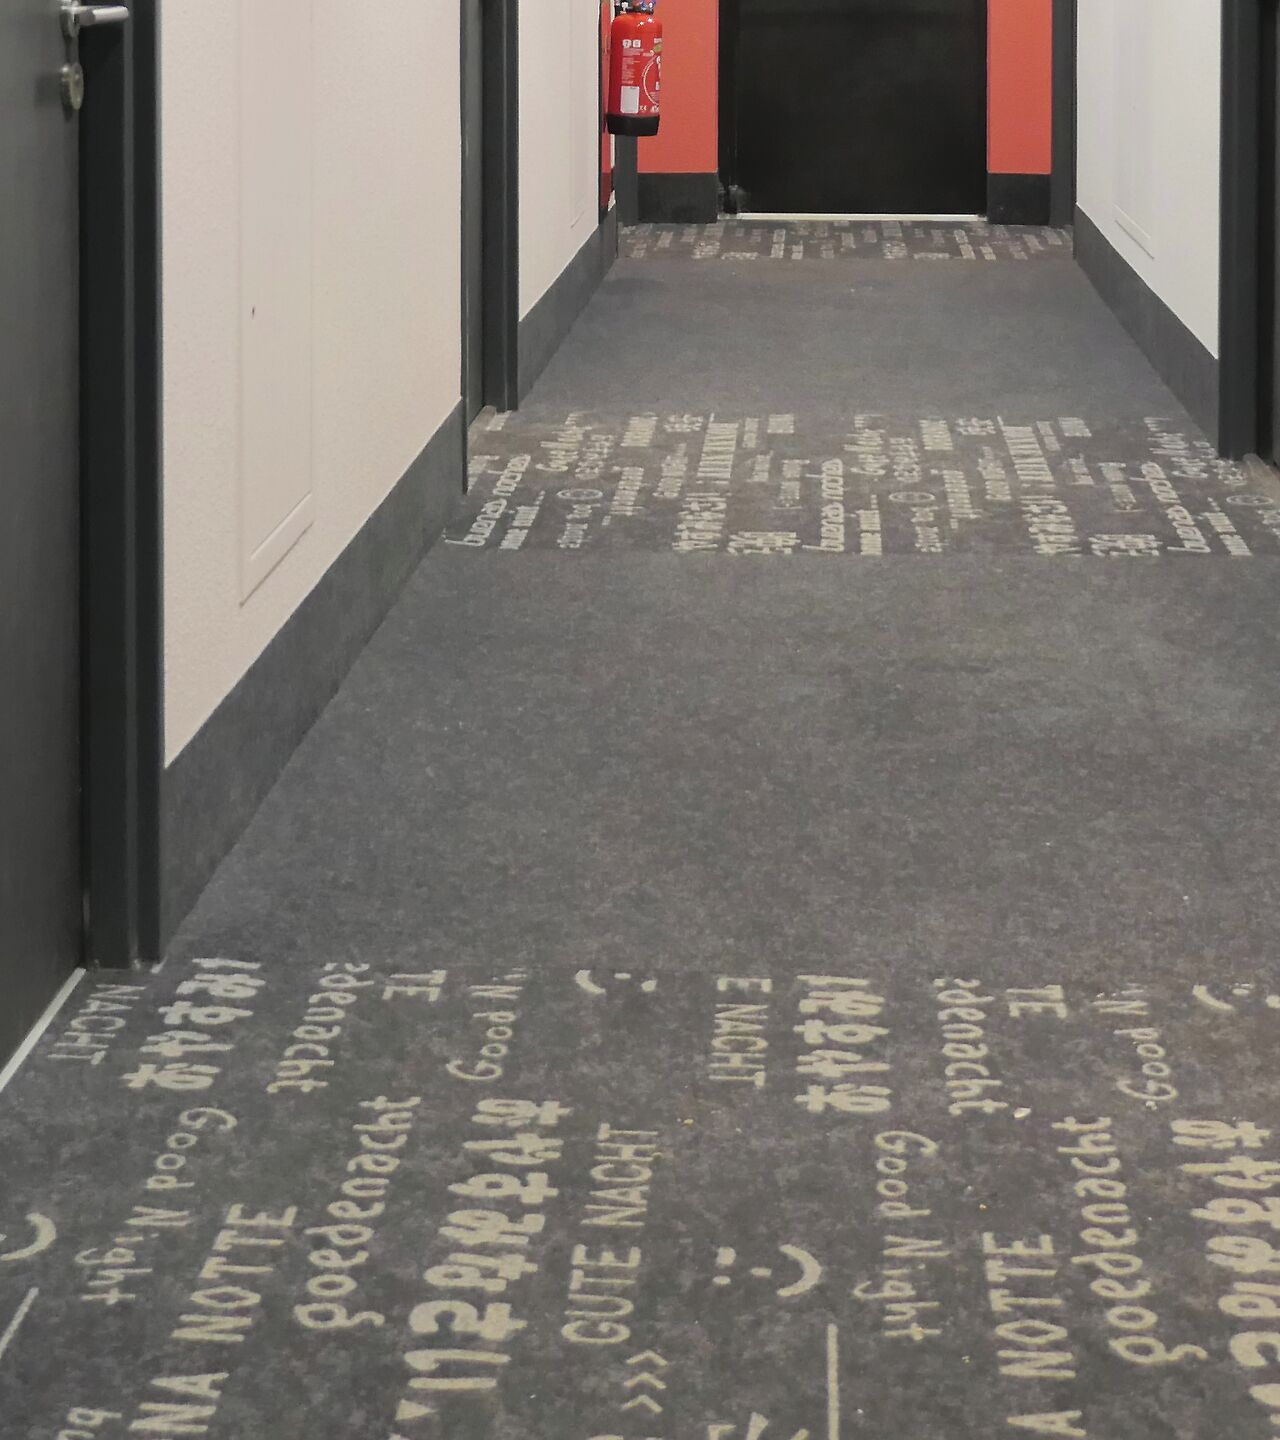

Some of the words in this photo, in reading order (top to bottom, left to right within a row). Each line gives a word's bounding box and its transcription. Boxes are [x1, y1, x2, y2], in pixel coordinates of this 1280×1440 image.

[443, 498, 508, 548] buenas
[487, 453, 532, 497] noches
[804, 458, 845, 500] noches
[1130, 460, 1181, 504] noches
[802, 501, 846, 553] buenas
[1163, 505, 1212, 554] buenas
[445, 1009, 518, 1082] Good
[708, 1002, 771, 1090] NACHT
[1113, 1025, 1179, 1101] Good
[144, 1105, 239, 1192] Good
[580, 1122, 662, 1228] NACHT
[874, 1129, 940, 1219] Good
[74, 1203, 192, 1307] Night
[292, 1093, 421, 1331] goedenacht
[1051, 1115, 1209, 1365] goedenacht
[170, 1202, 299, 1343] NOTTE
[560, 1241, 643, 1346] GUTE
[851, 1233, 952, 1343] Night
[982, 1230, 1077, 1380] NOTTE
[128, 1369, 230, 1439] NA
